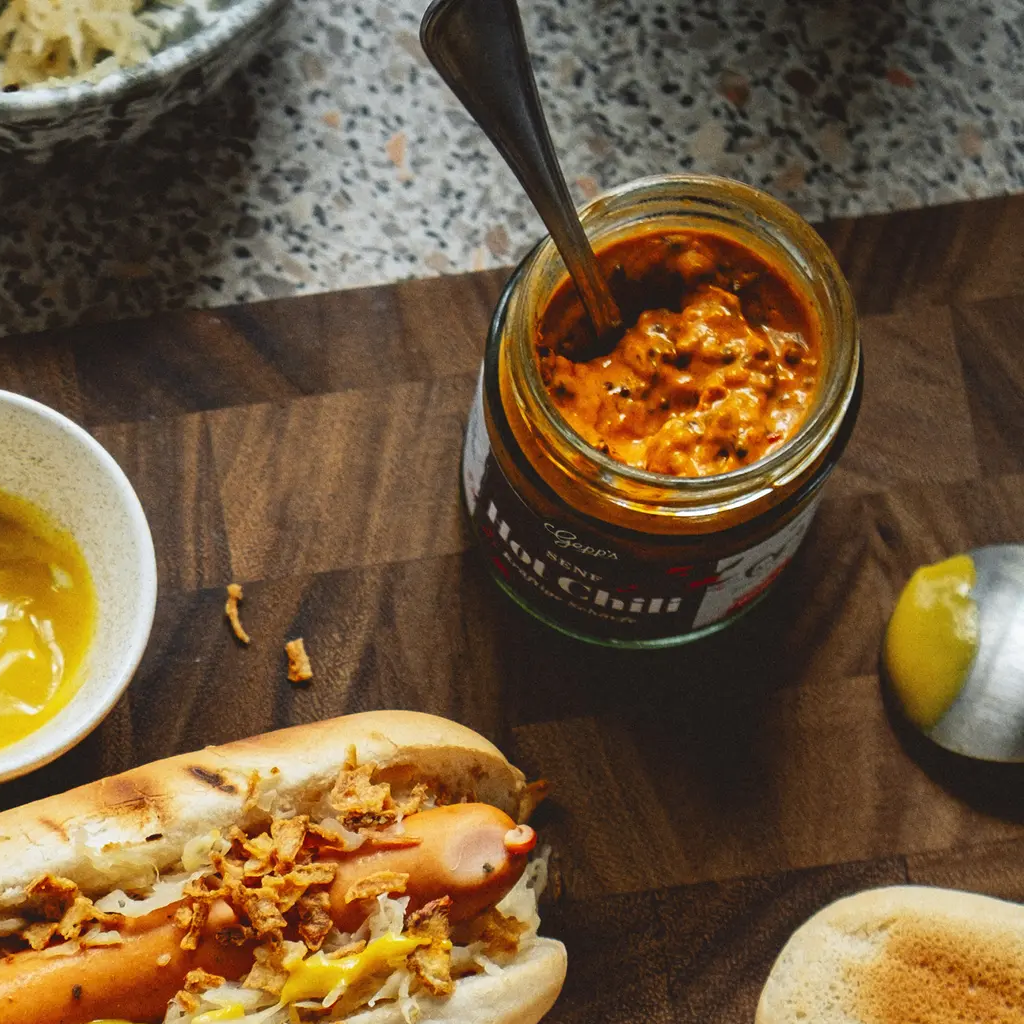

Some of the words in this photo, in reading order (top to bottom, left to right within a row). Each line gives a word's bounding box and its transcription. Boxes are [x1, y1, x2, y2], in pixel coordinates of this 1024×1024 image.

[543, 522, 619, 561] Gepp's
[545, 550, 603, 583] SENF
[557, 576, 683, 614] Chili
